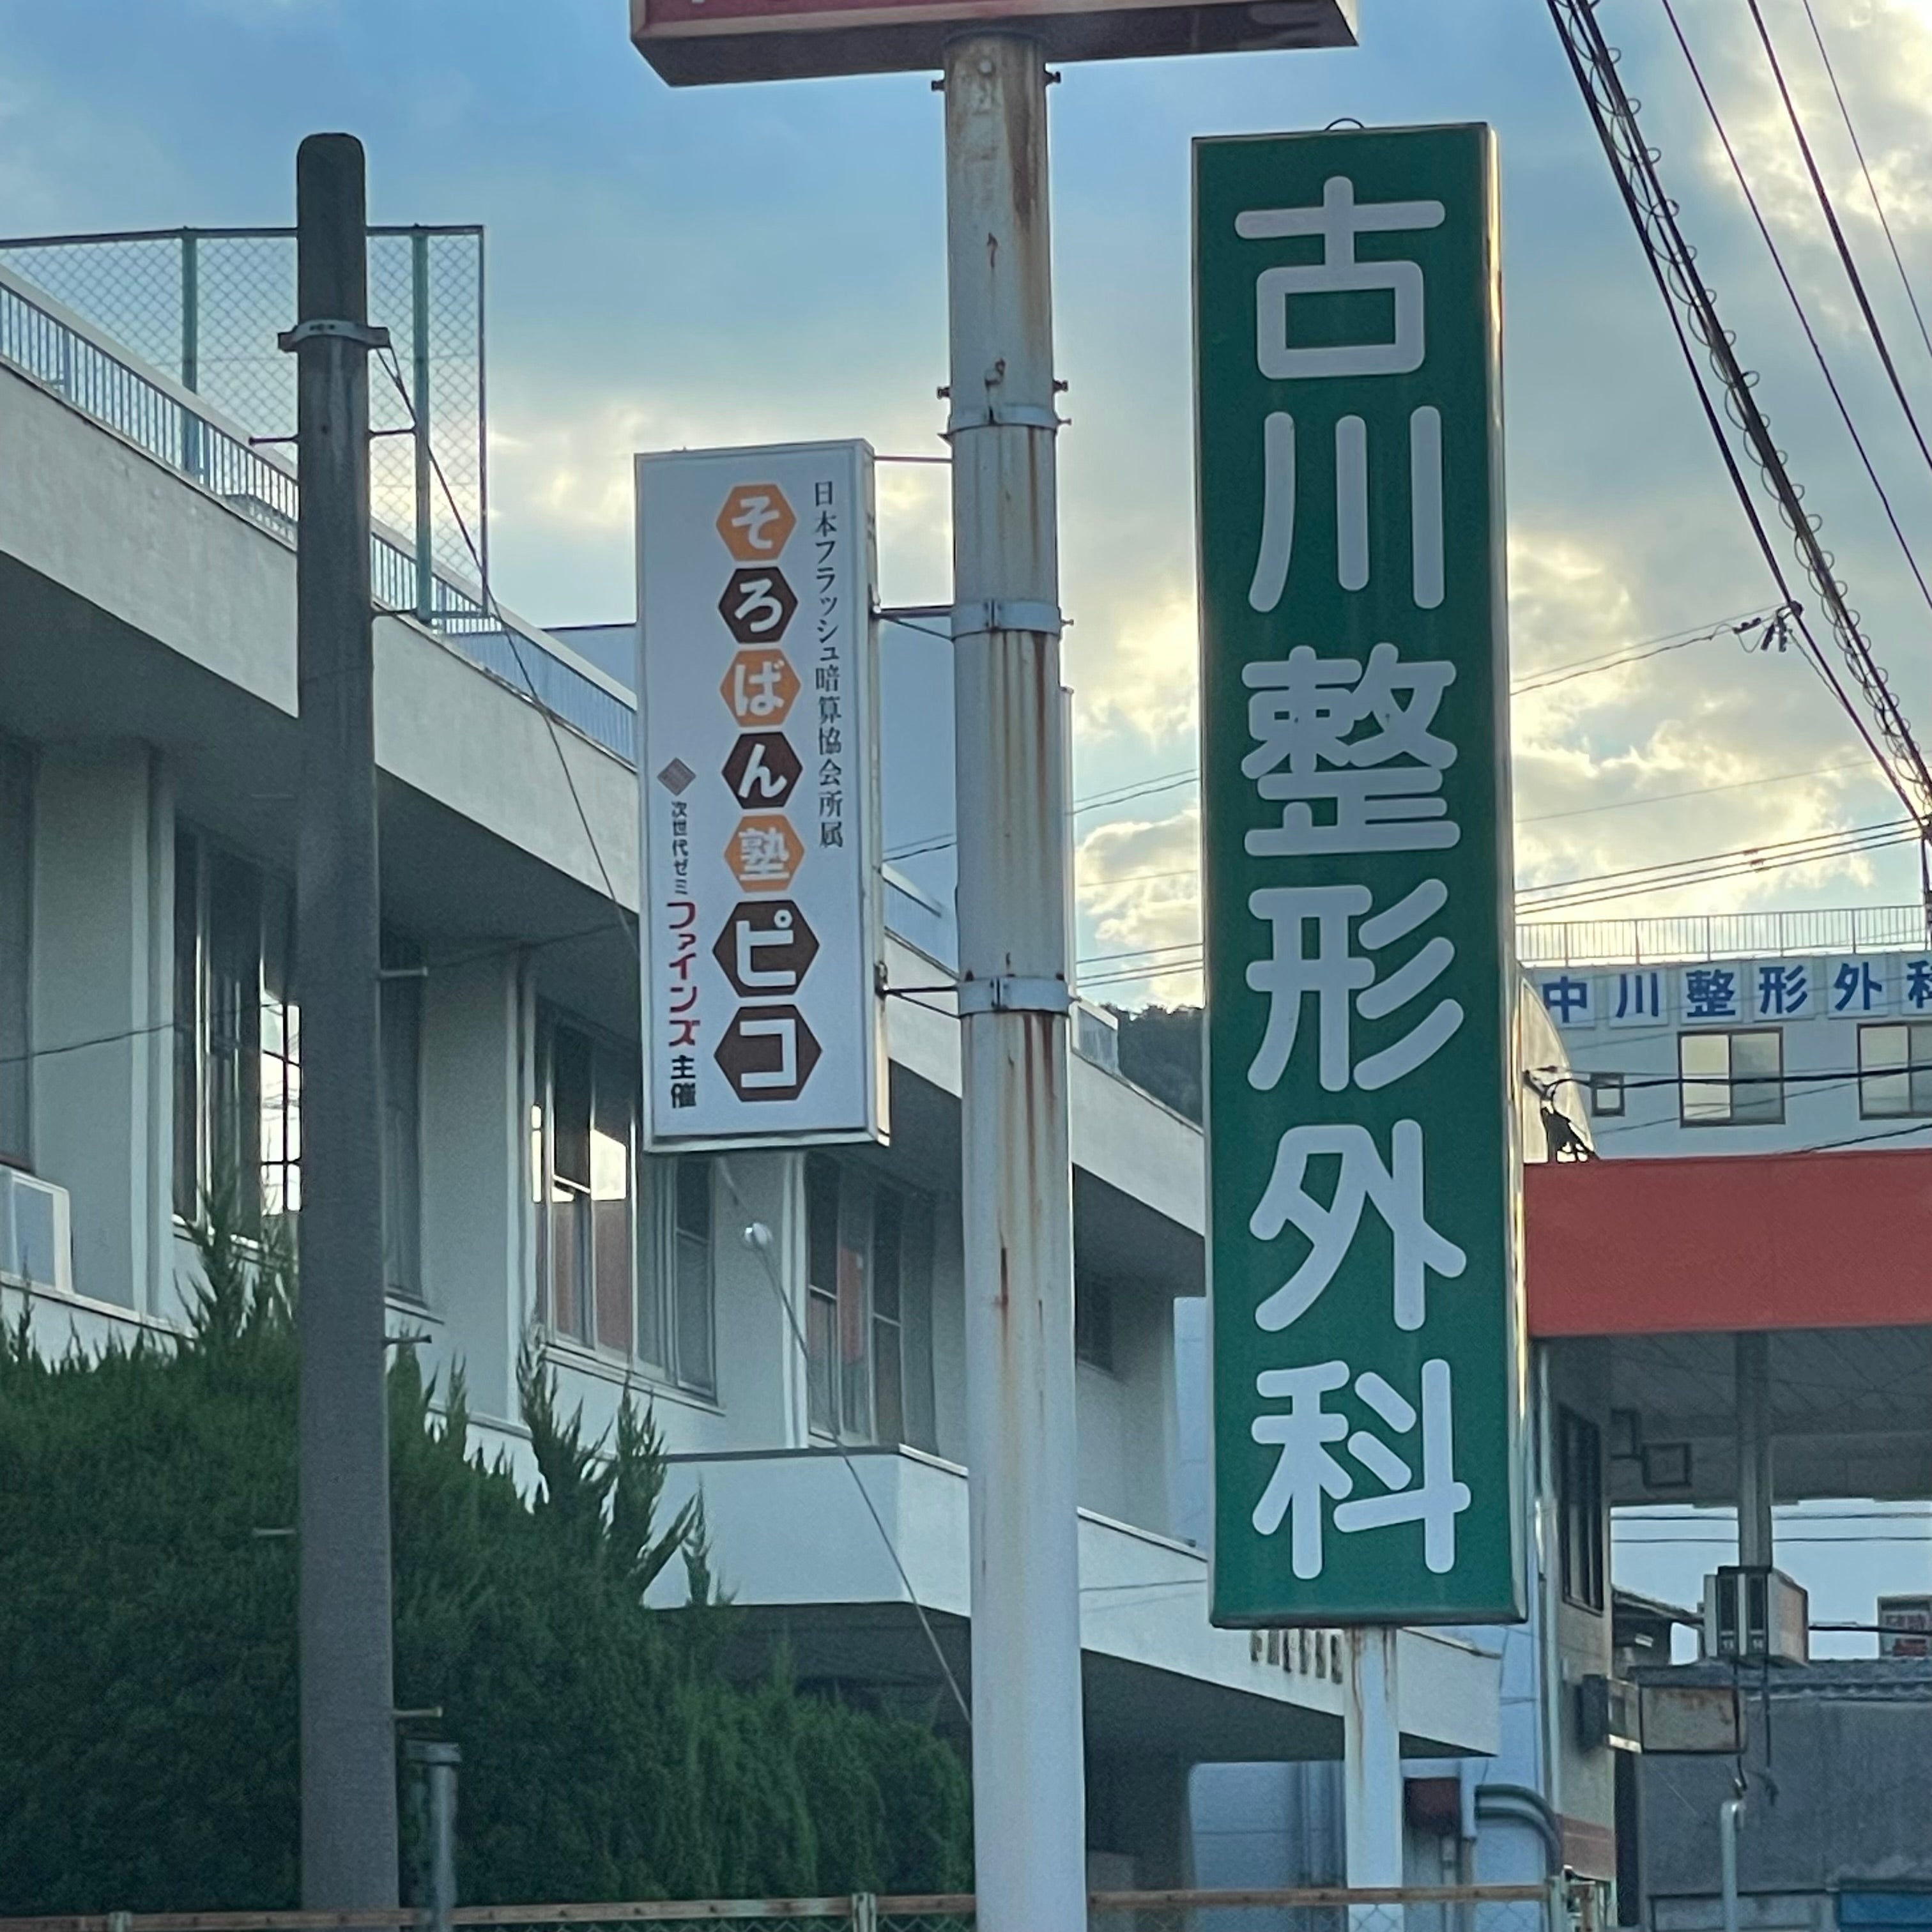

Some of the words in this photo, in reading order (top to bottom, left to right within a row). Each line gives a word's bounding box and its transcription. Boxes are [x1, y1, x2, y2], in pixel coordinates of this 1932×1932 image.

[731, 495, 797, 1088] そろばん塾ピコ
[815, 480, 843, 848] 日本フラッシュ暗算協会所属
[1234, 174, 1471, 1579] 古川整形外科
